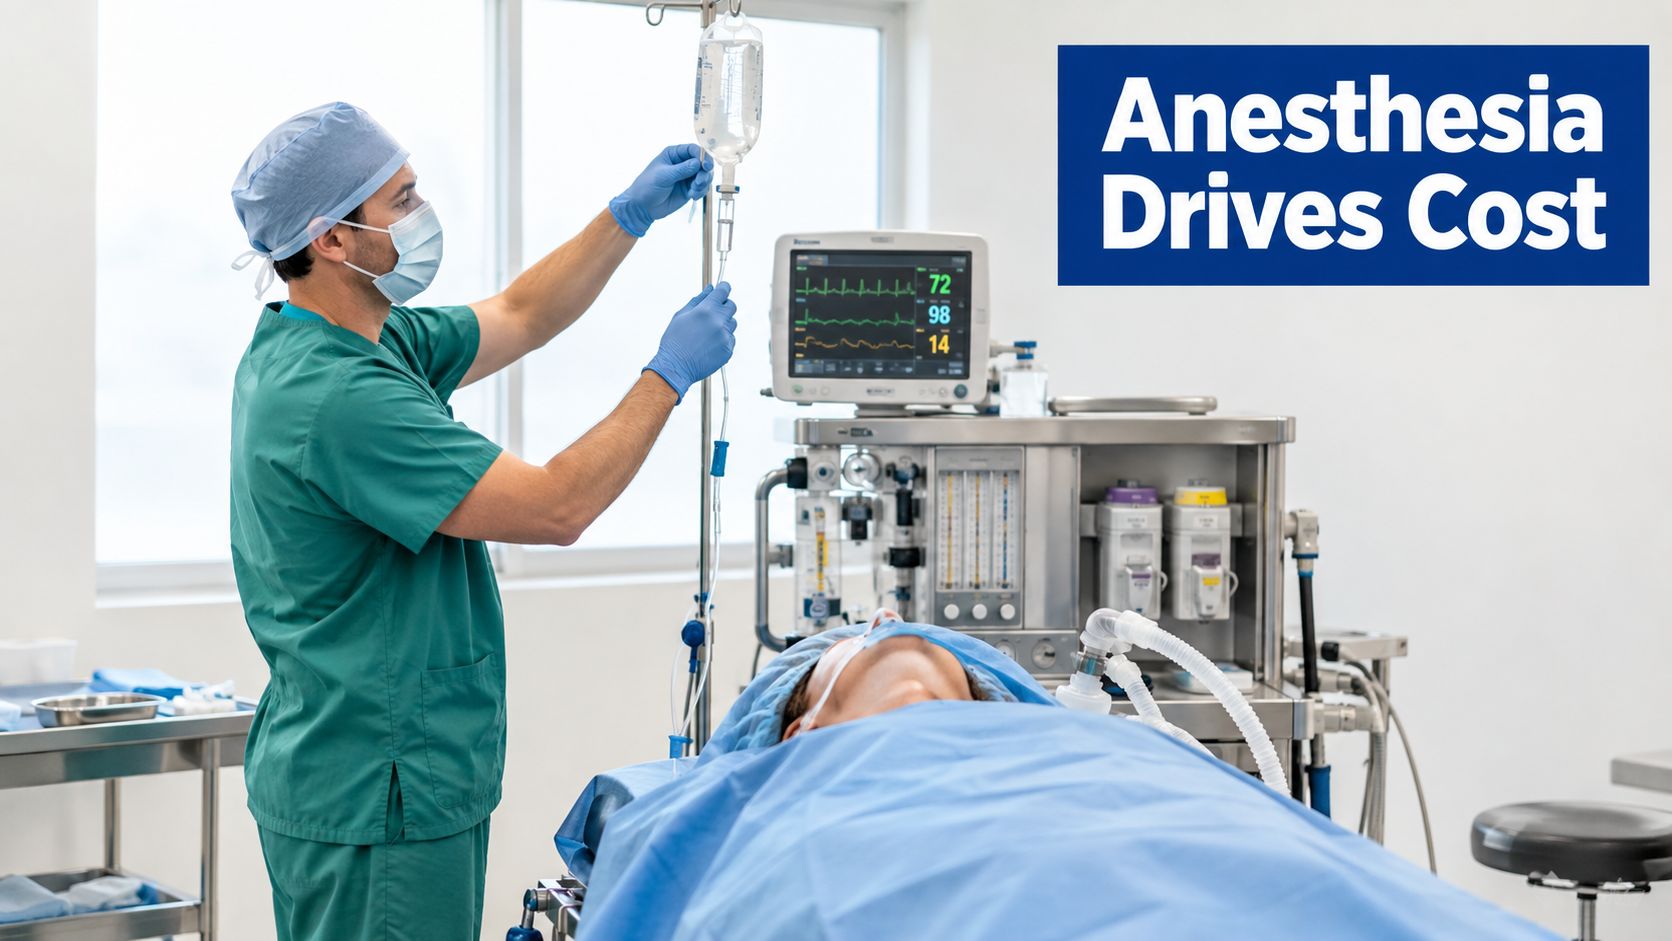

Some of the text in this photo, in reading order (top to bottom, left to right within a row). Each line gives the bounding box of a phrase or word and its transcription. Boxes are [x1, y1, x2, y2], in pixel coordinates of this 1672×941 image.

[929, 274, 952, 295] 72
[928, 305, 951, 325] 98
[928, 334, 950, 354] 14
